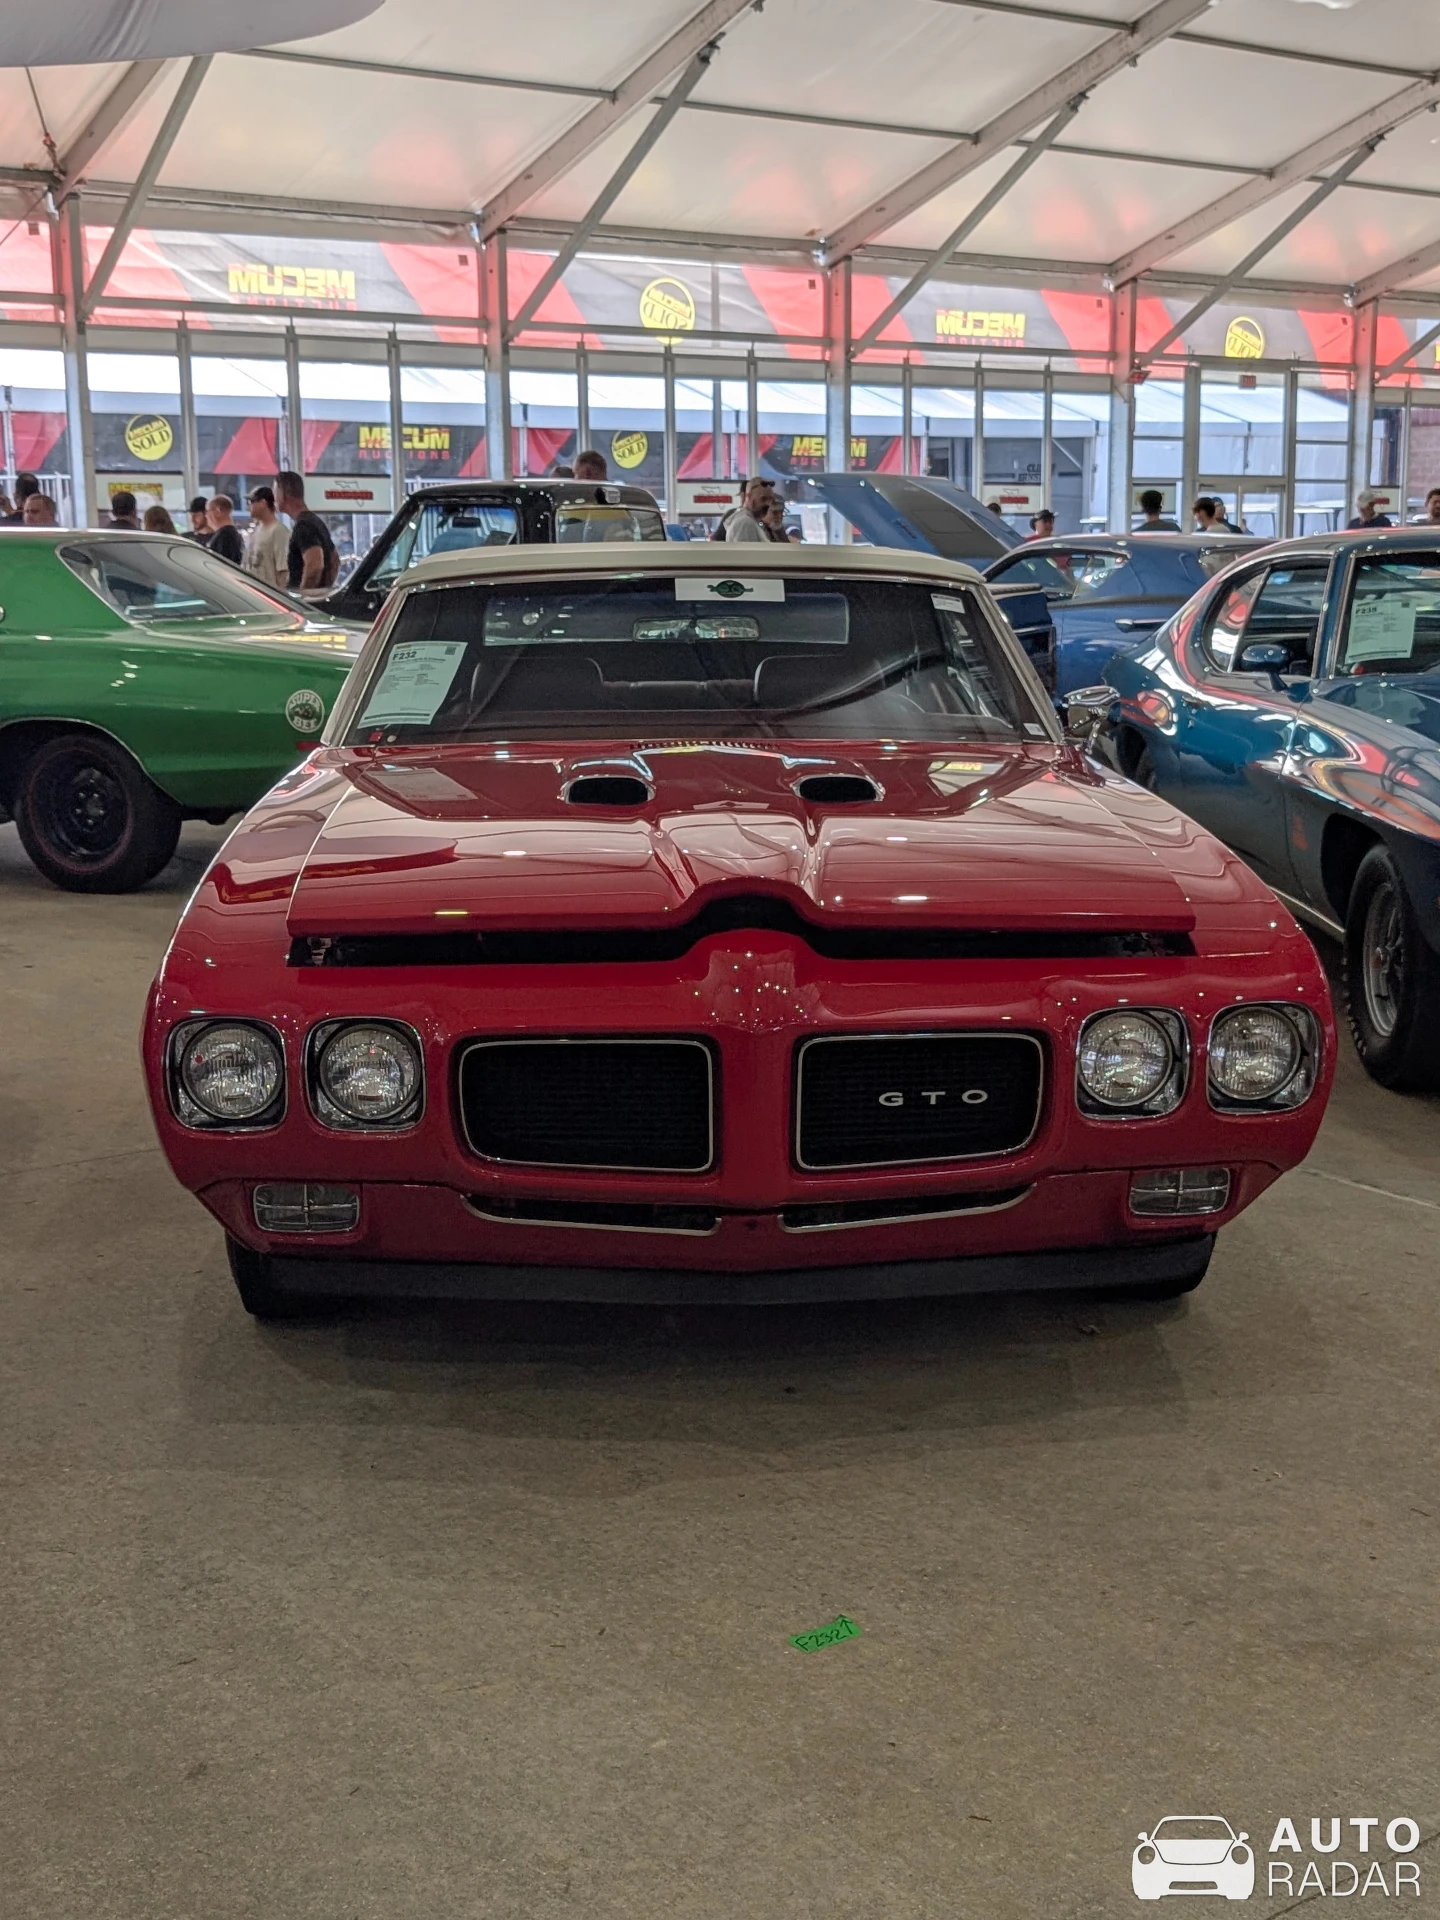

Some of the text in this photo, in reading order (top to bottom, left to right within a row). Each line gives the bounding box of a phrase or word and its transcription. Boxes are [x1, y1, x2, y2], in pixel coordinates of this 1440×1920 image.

[131, 429, 170, 453] SOLD
[615, 441, 645, 463] SOLD
[791, 435, 868, 458] MEM
[392, 650, 417, 661] F232
[289, 692, 321, 712] SUPER
[293, 715, 318, 730] BEE
[795, 1629, 847, 1652] F232
